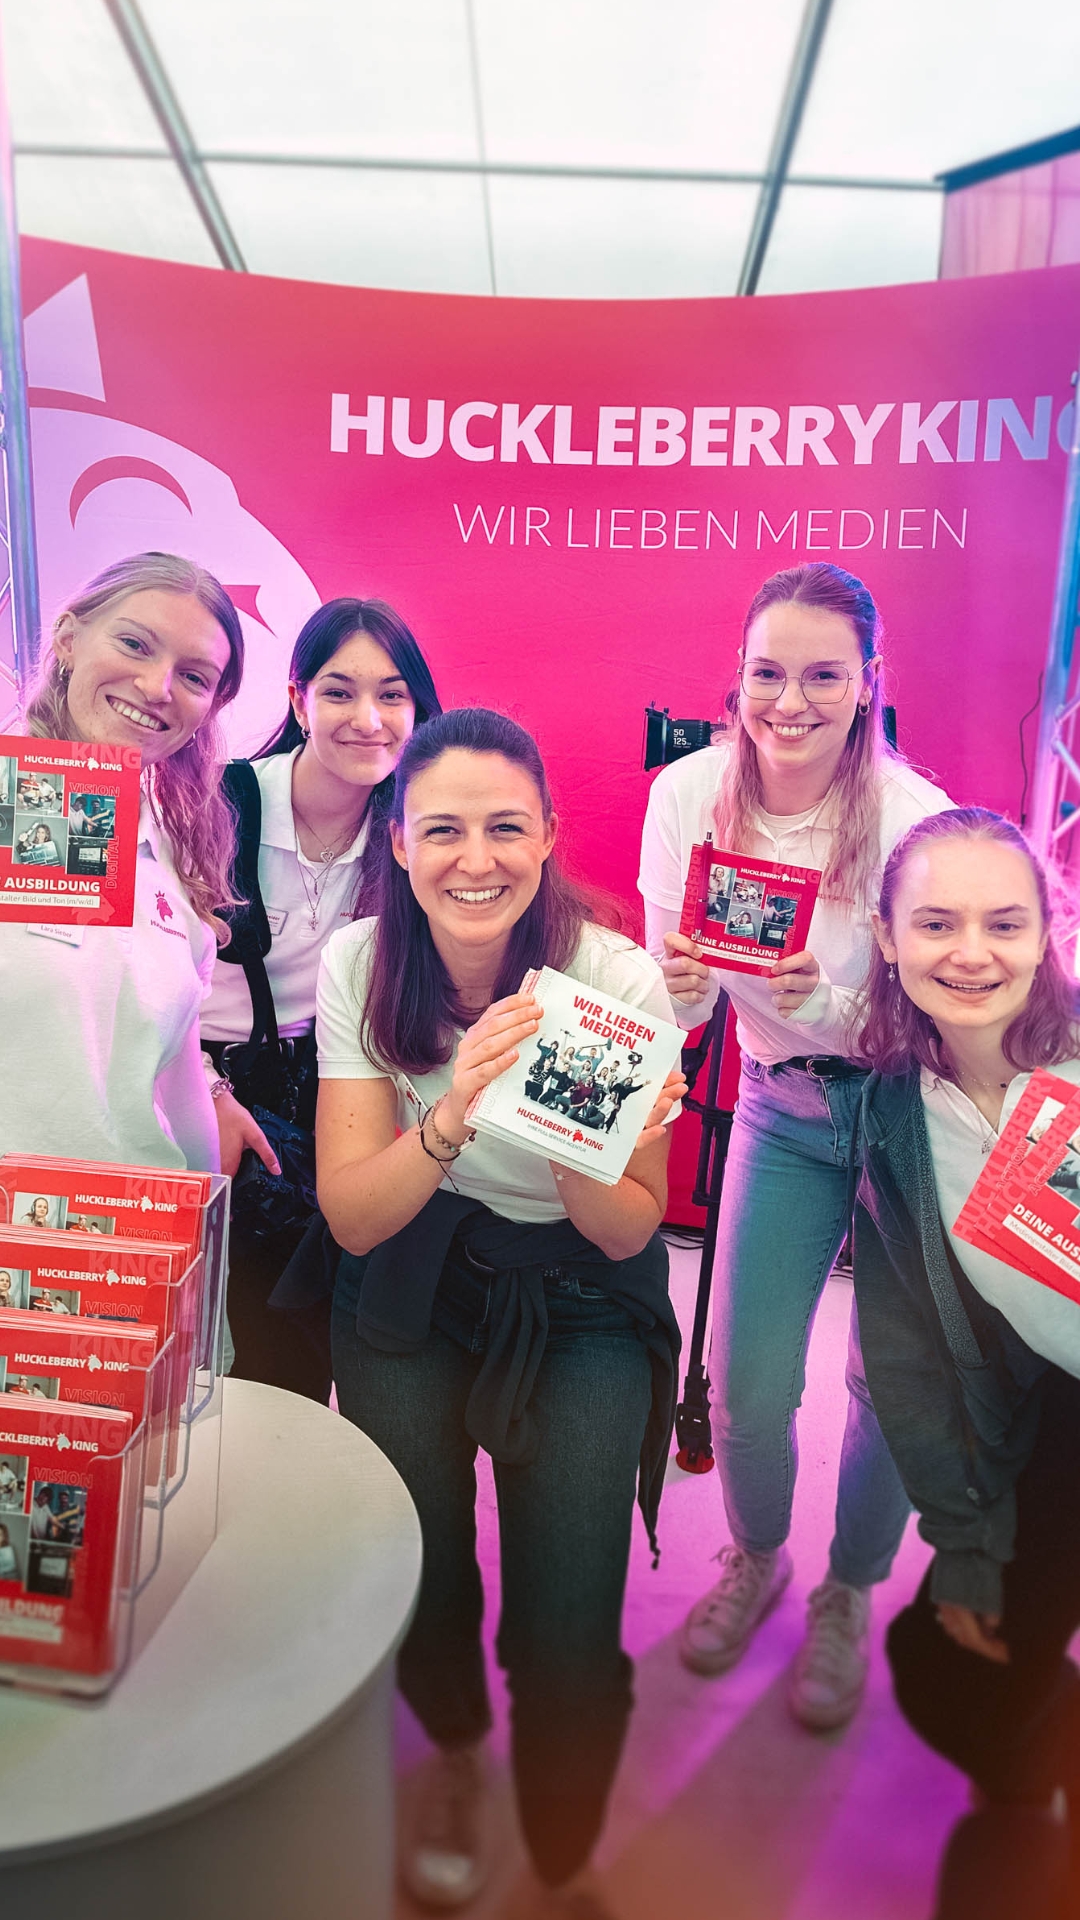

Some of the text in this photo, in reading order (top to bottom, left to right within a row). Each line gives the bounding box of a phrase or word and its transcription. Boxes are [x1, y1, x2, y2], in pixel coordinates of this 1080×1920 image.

[453, 503, 968, 550] WIR LIEBEN MEDIEN
[673, 728, 685, 737] 50
[24, 755, 123, 772] HUCKLEBERRY KING
[69, 782, 120, 798] VISION
[4, 876, 101, 893] AUSBILDUNG
[718, 940, 780, 959] AUSBILDUNG
[573, 995, 656, 1043] WIR LIEBEN
[579, 1015, 637, 1050] MEDIEN
[516, 1107, 605, 1151] HUCKLEBERRY KING
[75, 1194, 178, 1213] HUCKLEBERRY KING
[1013, 1203, 1054, 1238] DEINE
[37, 1267, 147, 1286] HUCKLEBERRY KING
[85, 1300, 144, 1318] VISION
[14, 1353, 130, 1372] HUCKLEBERRY KING
[64, 1387, 126, 1408] VISION
[72, 1440, 99, 1453] KING
[33, 1466, 94, 1489] VISION
